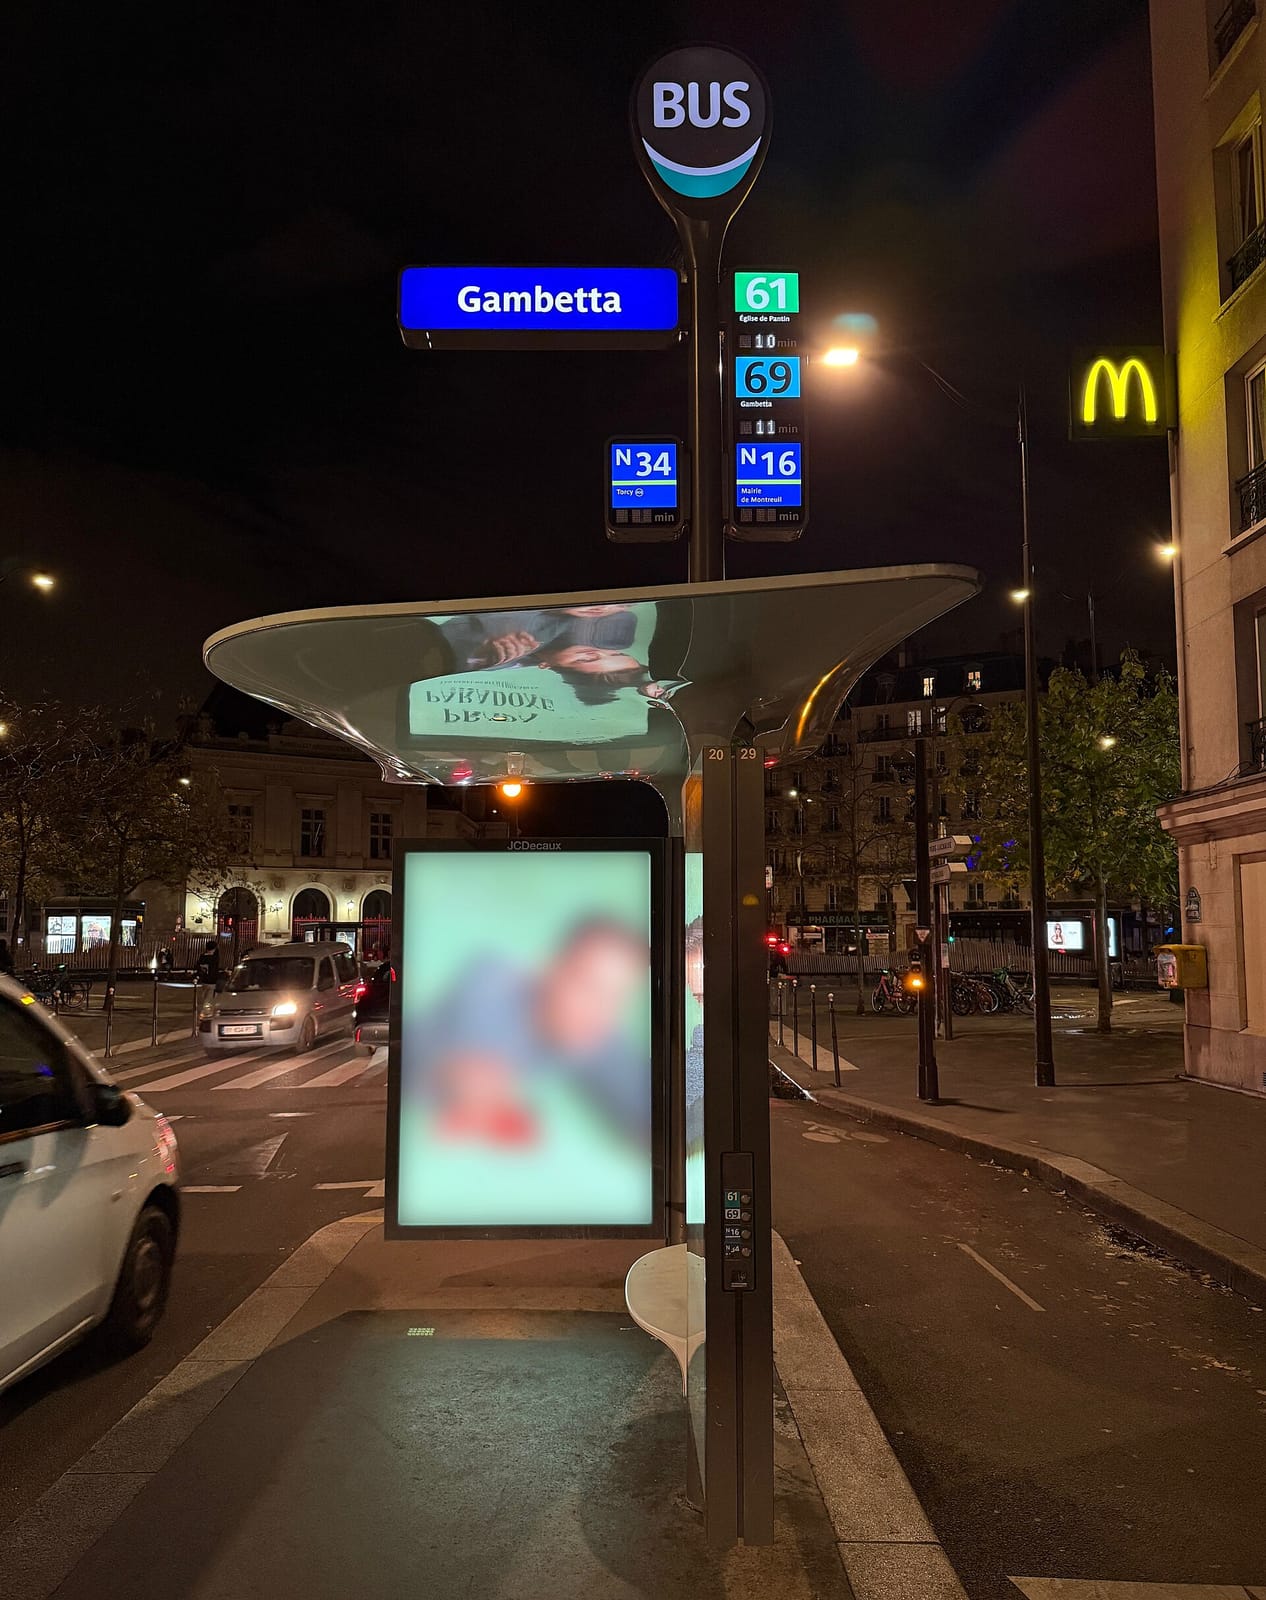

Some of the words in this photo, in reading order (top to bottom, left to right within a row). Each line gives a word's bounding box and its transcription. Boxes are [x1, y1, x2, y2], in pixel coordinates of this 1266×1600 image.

[652, 81, 751, 129] BUS
[745, 277, 787, 309] 61
[457, 285, 622, 313] Gambetta
[739, 314, 759, 323] Église
[755, 333, 776, 348] 10
[777, 338, 797, 348] min
[744, 361, 792, 394] 69
[740, 399, 773, 408] Gambetta
[756, 419, 776, 435] 11
[778, 424, 798, 433] min
[616, 488, 634, 497] Torcy
[654, 512, 675, 522] min
[779, 511, 799, 521] min
[708, 748, 724, 760] 20
[740, 748, 757, 760] 29
[507, 840, 562, 850] JCDecaux
[808, 915, 868, 924] PHARMACE
[727, 1192, 738, 1201] 61
[727, 1209, 738, 1218] 69
